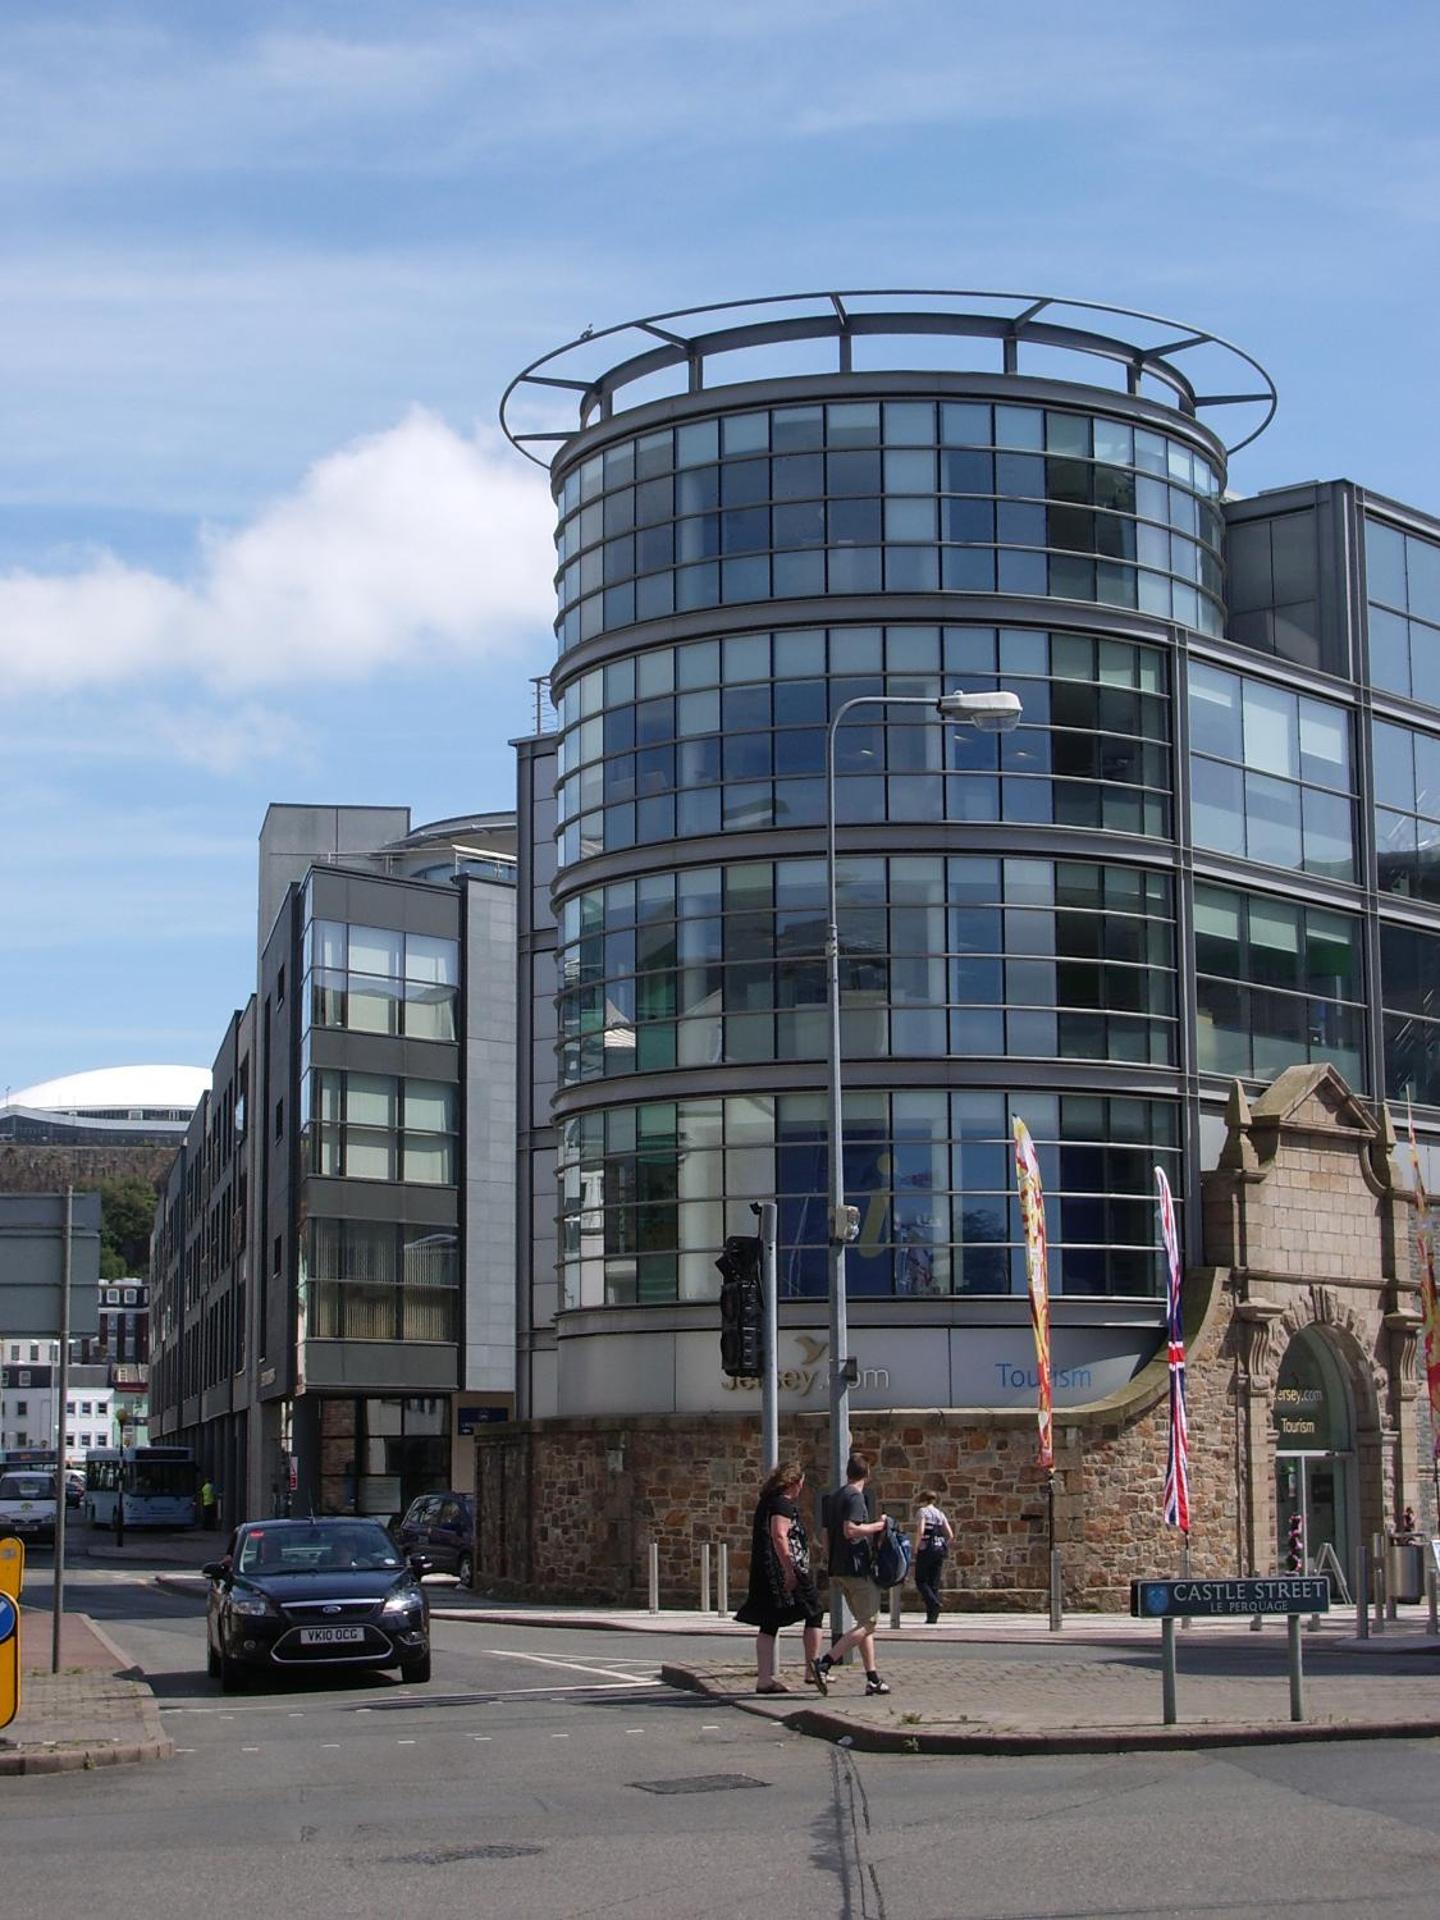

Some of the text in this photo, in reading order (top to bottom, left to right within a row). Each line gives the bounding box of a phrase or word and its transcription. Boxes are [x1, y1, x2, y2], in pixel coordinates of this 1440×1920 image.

[995, 1363, 1092, 1388] Touism
[1280, 1417, 1315, 1433] Tourism
[1174, 1581, 1324, 1601] CASTLE STREET
[1210, 1600, 1288, 1613] LE PERQUAGE
